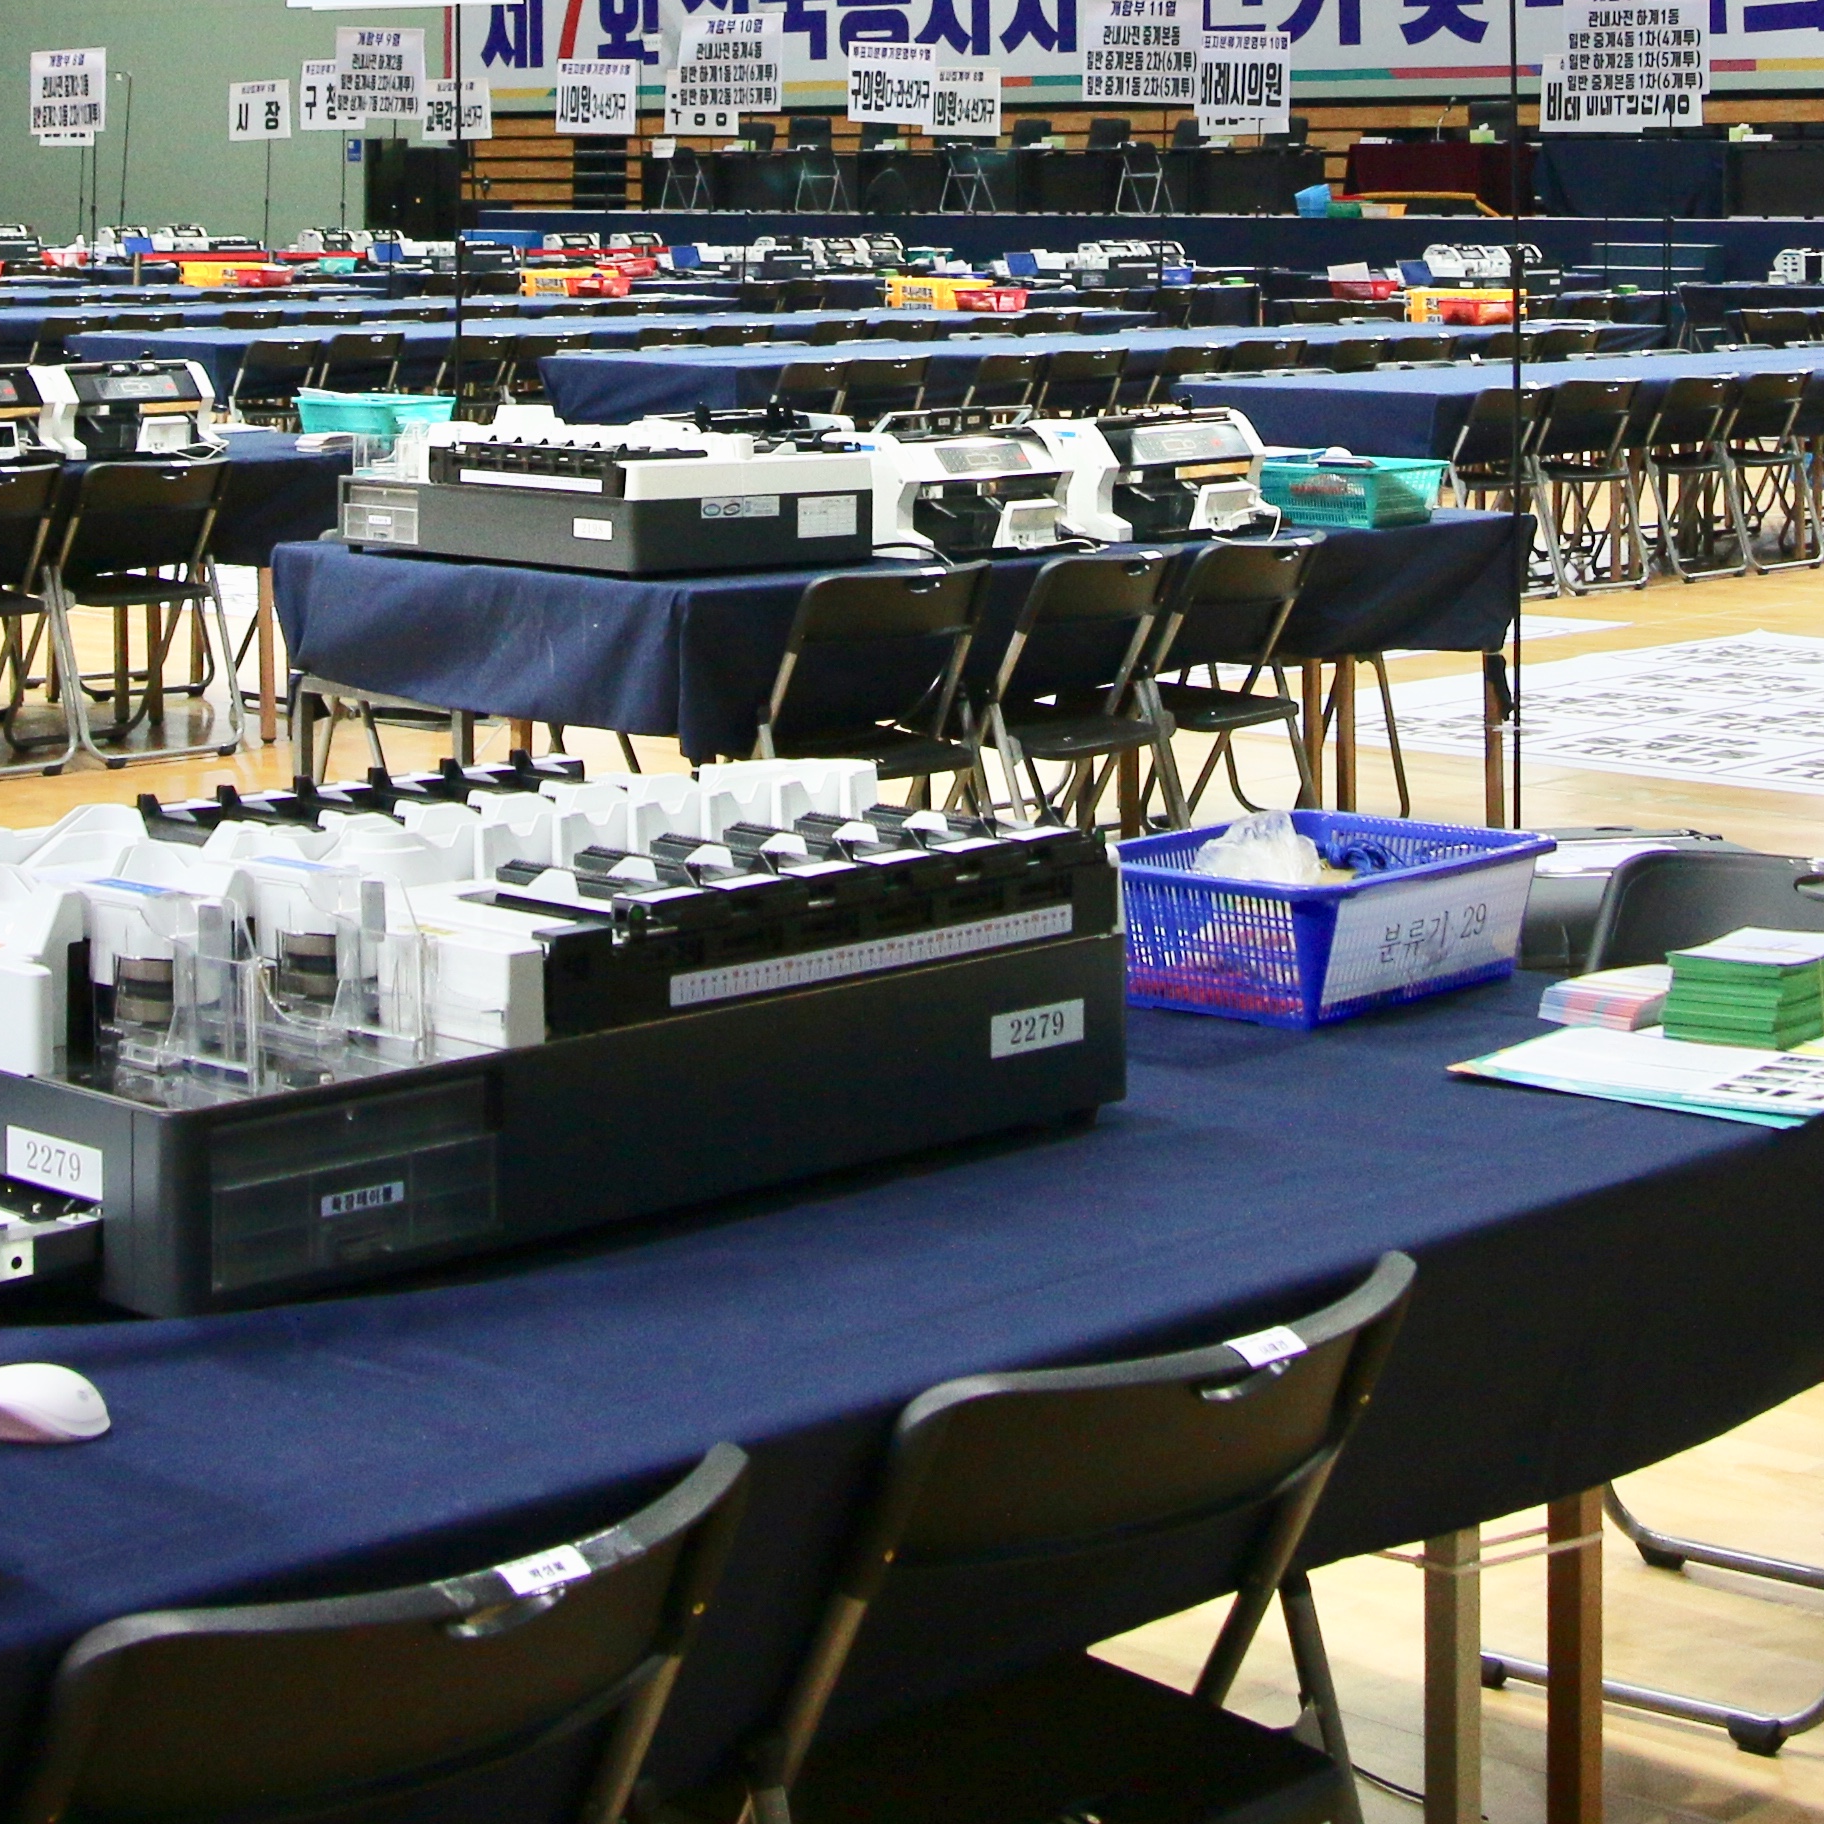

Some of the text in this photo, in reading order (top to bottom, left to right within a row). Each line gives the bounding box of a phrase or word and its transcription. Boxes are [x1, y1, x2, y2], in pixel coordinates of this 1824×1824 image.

[1110, 1, 1177, 16] 개함부 11열
[1588, 8, 1679, 27] 관내사전 하계1동
[706, 19, 764, 34] 개함부 10열
[1103, 26, 1140, 46] 관내사전
[1202, 36, 1267, 50] 표지분류기운영부
[1569, 32, 1591, 49] 일반
[1569, 54, 1591, 70] 일반
[1567, 76, 1588, 91] 일반
[1378, 903, 1487, 963] 분류기 29
[1009, 1008, 1067, 1049] 2279
[26, 1140, 83, 1183] 2279
